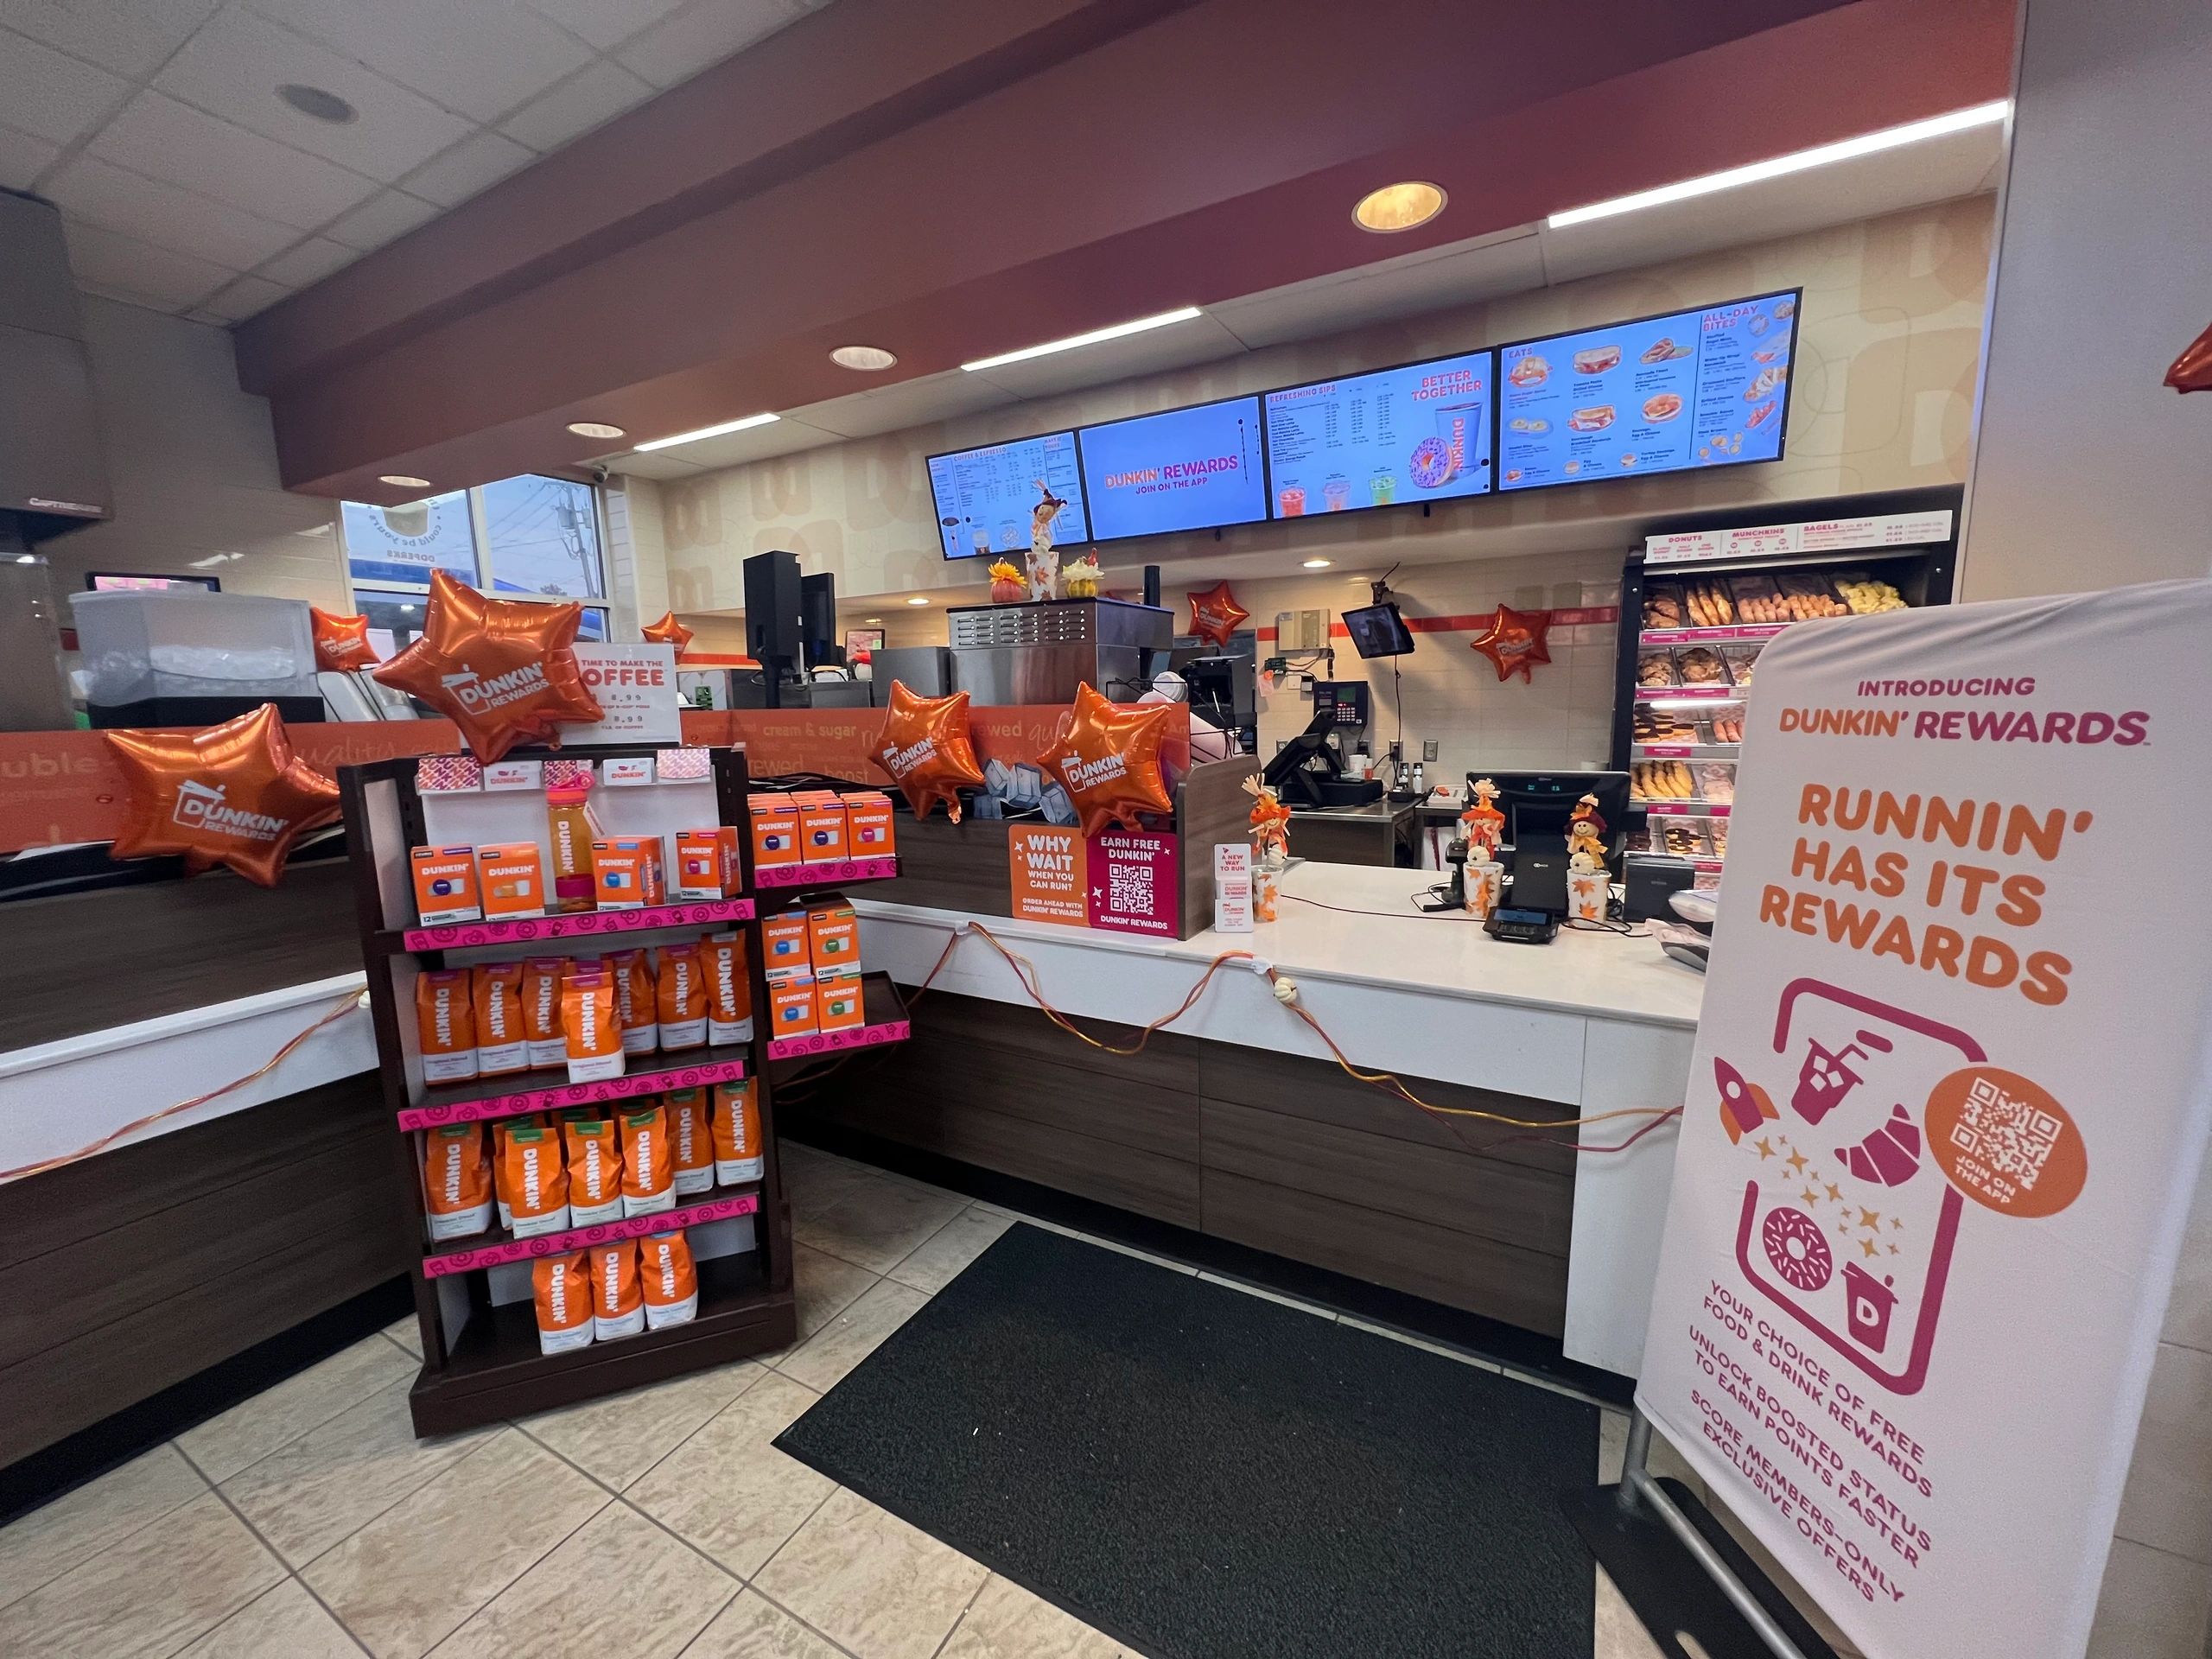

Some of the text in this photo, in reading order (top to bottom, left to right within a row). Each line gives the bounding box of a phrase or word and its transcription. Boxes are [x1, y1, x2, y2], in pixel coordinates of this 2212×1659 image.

[1704, 305, 1758, 322] ALL-DAY
[1703, 319, 1736, 332] BITES
[1509, 347, 1533, 359] EATS
[1411, 380, 1482, 401] TOGETHER
[1421, 370, 1471, 388] BETTER
[1270, 385, 1336, 403] REFRESHING SIPS
[980, 448, 1007, 457] ESPRESSO
[1105, 455, 1238, 488] DUNKIN' REWARDS
[1136, 477, 1208, 494] JOIN ON THE APP
[1669, 535, 1702, 543] DONUTS
[1732, 528, 1785, 537] MUNCHKINS
[1803, 523, 1839, 532] BAGELS
[460, 662, 543, 704] DUNKIN'
[582, 669, 664, 686] OFFEE
[1858, 677, 2036, 696] INTRODUCING
[491, 678, 550, 707] REWARDS
[763, 724, 801, 735] cream
[805, 722, 817, 735] &
[820, 724, 857, 741] sugar
[1780, 709, 2150, 746] DUNKIN' REWARDS
[891, 736, 933, 770] DUNKIN'
[905, 749, 938, 772] REWARDS
[1070, 752, 1125, 783] DUNKIN'
[1085, 766, 1127, 787] REWARDS
[183, 799, 289, 833] DUNKIN'
[757, 822, 795, 831] DUNKIN'
[806, 817, 842, 827] DUNKIN'
[854, 815, 889, 823] DUNKIN'
[1798, 783, 2094, 861] RUNNIN'
[204, 821, 276, 841] REWARDS
[558, 820, 575, 873] DUNKIN'
[1027, 835, 1071, 853] WHY
[1100, 836, 1160, 851] EARN FREE
[1027, 852, 1073, 871] WAIT
[1109, 849, 1154, 862] DUNKIN'
[422, 863, 469, 875] DUNKIN'
[488, 864, 535, 876] DUNKIN'
[1027, 870, 1074, 881] WHEN YOU
[1030, 880, 1072, 892] CAN RUN?
[1791, 837, 2046, 927] HAS ITS
[1023, 905, 1084, 918] DUNKIN' REWARDS
[1043, 899, 1065, 907] AHEAD
[1065, 900, 1083, 909] WITH
[768, 925, 804, 937] DUNKIN'
[817, 924, 853, 936] DUNKIN'
[1100, 915, 1168, 931] DUNKIN' REWARDS
[1759, 884, 2072, 1006] REWARDS
[676, 962, 688, 1015] DUNKIN'
[718, 948, 736, 1016] DUNKIN'
[823, 986, 859, 998] DUNKIN'
[537, 976, 553, 1033] DUNKIN'
[778, 991, 813, 1004] DUNKIN'
[435, 988, 451, 1046] DUNKIN'
[490, 981, 505, 1038] DUNKIN'
[582, 992, 597, 1051] DUNKIN'
[680, 1108, 693, 1163] DUNKIN'
[731, 1099, 746, 1154] DUNKIN'
[585, 1139, 601, 1199] DUNKIN'
[638, 1130, 652, 1191] DUNKIN'
[446, 1143, 461, 1205] DUNKIN'
[524, 1147, 541, 1210] DUNKIN'
[1955, 1155, 2016, 1197] JOIN ON
[1955, 1164, 2011, 1204] THE APP
[605, 1252, 619, 1313] DUNKIN'
[658, 1244, 676, 1298] DUNKIN'
[550, 1263, 567, 1324] DUNKIN'
[1710, 1280, 1925, 1465] YOUR CHOICE OF FREE
[1703, 1296, 1932, 1498] FOOD & DRINK REWARDS
[1689, 1325, 1932, 1552] UNLOCK BOOSTED STATUS
[1694, 1350, 1919, 1568] TO EARN POINTS FASTER
[1691, 1389, 1906, 1603] SCORE MEMBERS-ONLY
[1703, 1421, 1874, 1603] EXCLUSIVE OFFERS
